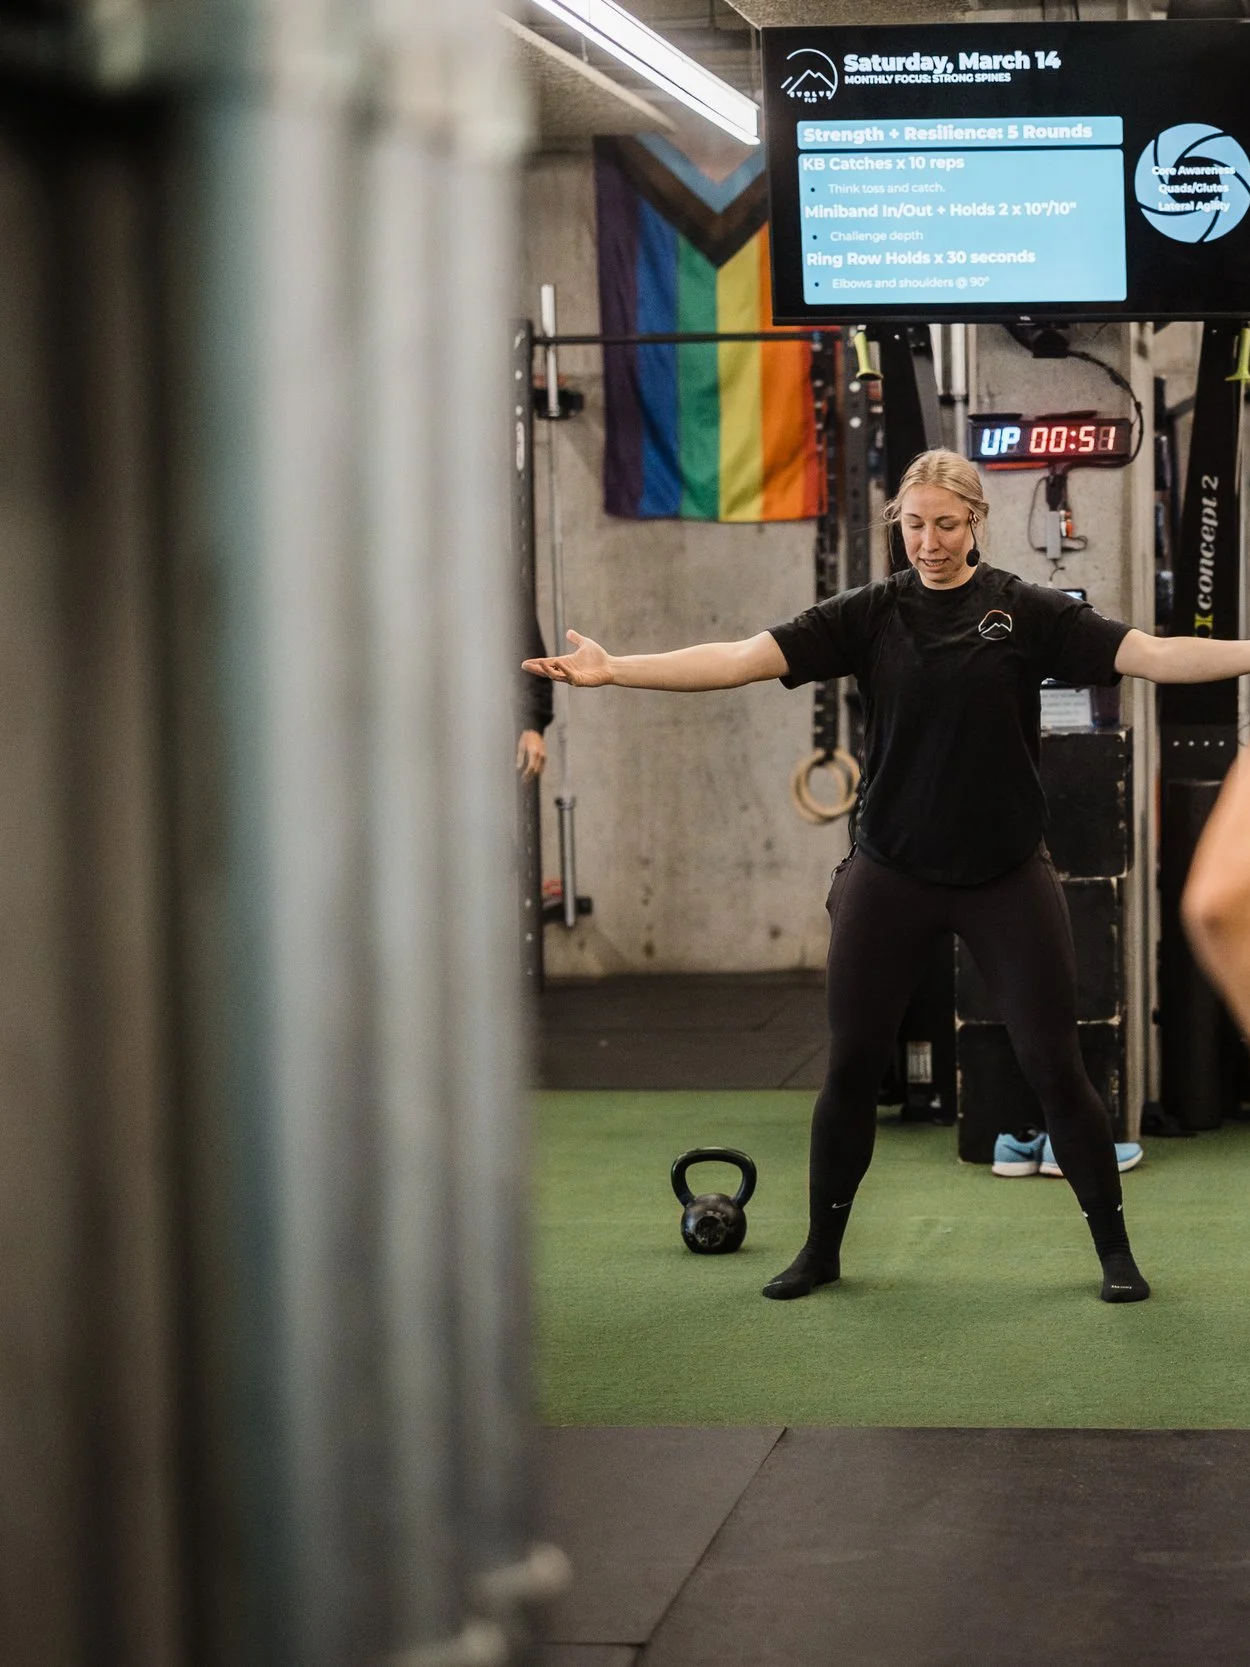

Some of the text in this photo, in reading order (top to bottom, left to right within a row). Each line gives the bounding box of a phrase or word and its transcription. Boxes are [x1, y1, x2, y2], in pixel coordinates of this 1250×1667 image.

[843, 50, 1061, 74] Saturday, March 14
[845, 73, 1011, 85] MONTHLY FOCUS: STRONG SPINES
[803, 124, 1093, 144] Strength + Resilience: 5 Rounds
[802, 156, 965, 171] KB Catches x 10 reps
[1151, 165, 1236, 175] Core Awareness
[828, 182, 946, 194] Think toss and catch.
[1158, 182, 1229, 194] Quads/Glutes
[804, 203, 879, 218] Miniband
[882, 202, 933, 217] In/Out
[937, 204, 946, 215] +
[951, 201, 996, 216] Holds
[999, 202, 1009, 215] 2
[1012, 205, 1021, 215] x
[1158, 200, 1231, 212] Lateral Agility
[830, 230, 924, 242] Challenge depth
[807, 249, 1036, 267] Ring Row Holds x 30 seconds
[832, 277, 873, 289] Elbows
[875, 278, 898, 288] and
[899, 276, 954, 288] shoulders
[980, 426, 1116, 456] UP 00:51
[1198, 475, 1219, 610] concept 2
